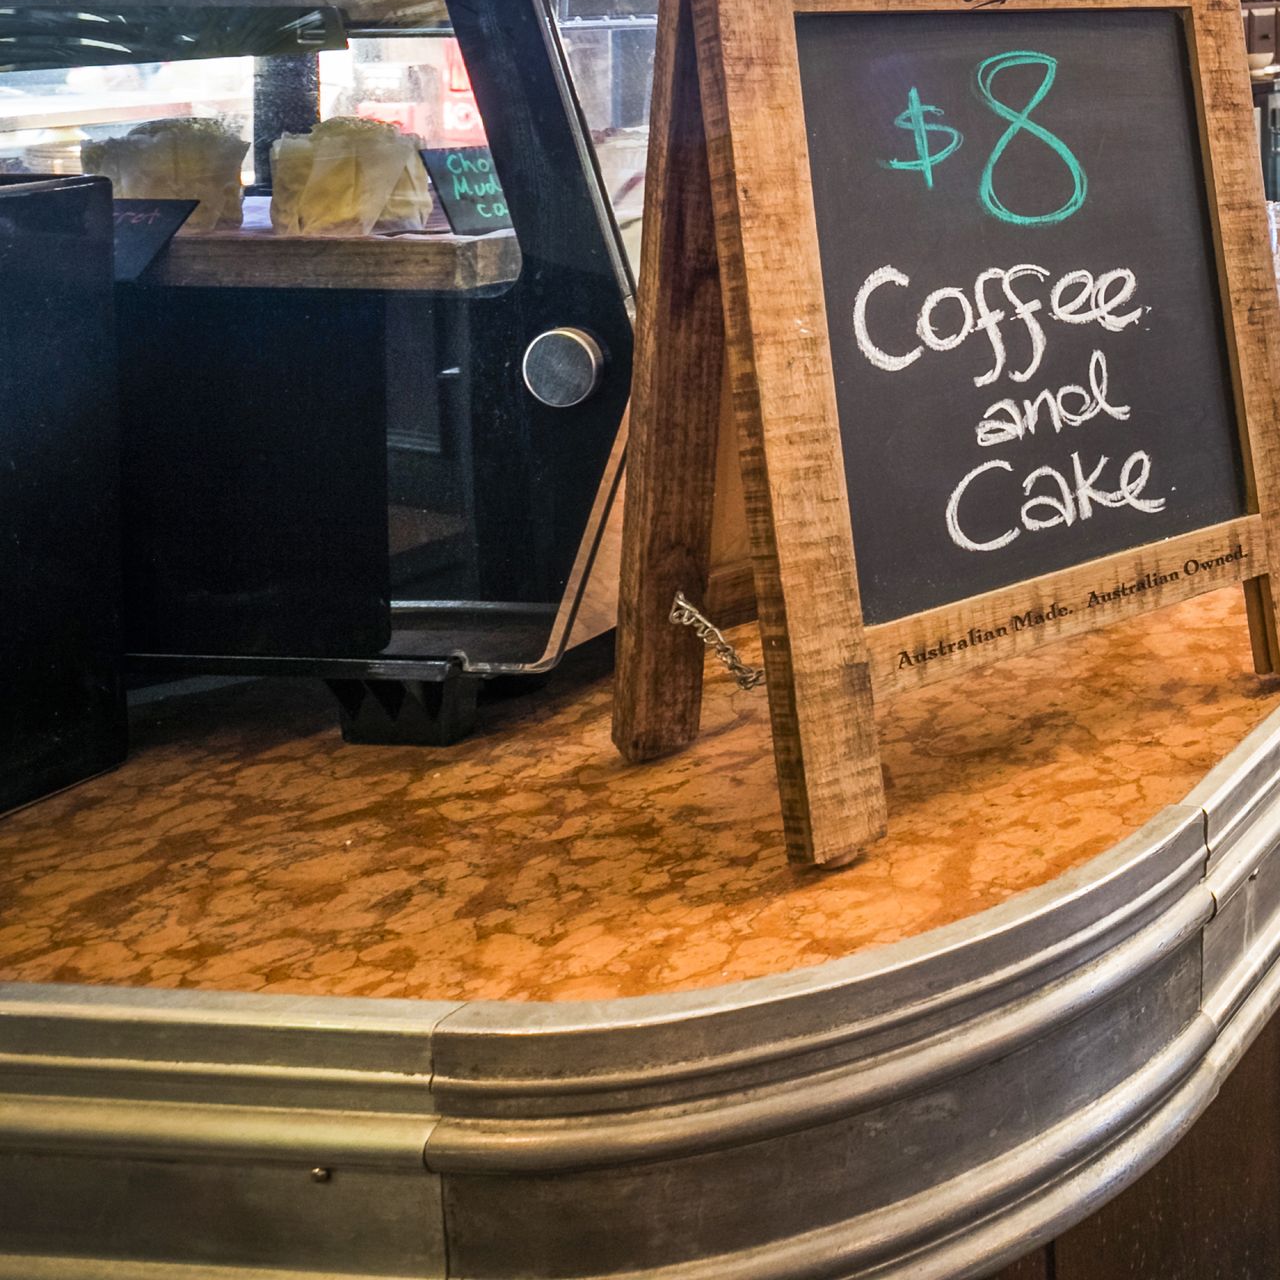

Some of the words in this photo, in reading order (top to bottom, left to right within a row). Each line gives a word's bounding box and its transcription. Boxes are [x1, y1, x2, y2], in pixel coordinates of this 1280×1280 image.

[453, 174, 503, 201] Mud
[852, 263, 1147, 388] Coffee
[975, 349, 1134, 448] and
[897, 622, 1008, 670] Australian
[1010, 604, 1074, 633] Made.
[1087, 571, 1181, 609] Australian
[1183, 545, 1249, 577] Owned.
